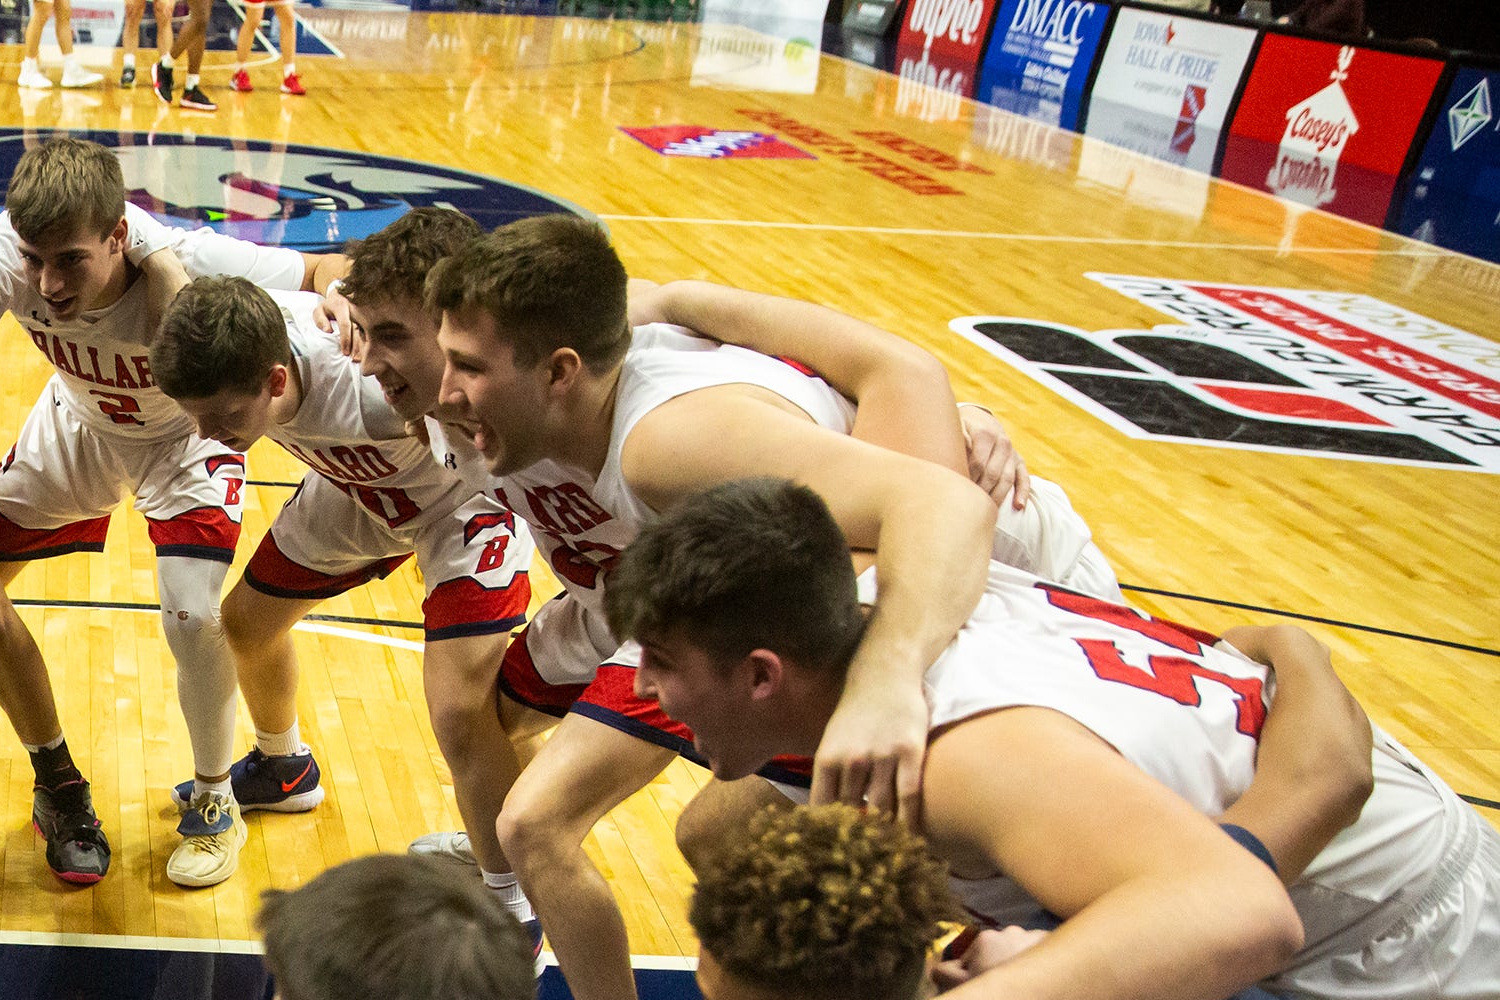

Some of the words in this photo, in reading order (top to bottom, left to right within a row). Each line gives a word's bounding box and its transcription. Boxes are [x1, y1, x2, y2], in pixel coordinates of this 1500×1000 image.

[1010, 0, 1096, 46] DMACC
[1133, 20, 1169, 45] IOWA
[1125, 45, 1158, 71] HALL
[1160, 53, 1176, 73] of
[1175, 54, 1220, 82] PRIDE
[1290, 107, 1348, 152] Casey's
[28, 327, 156, 389] BALLAR
[89, 389, 145, 426] 2
[221, 477, 243, 506] B
[475, 534, 510, 574] B
